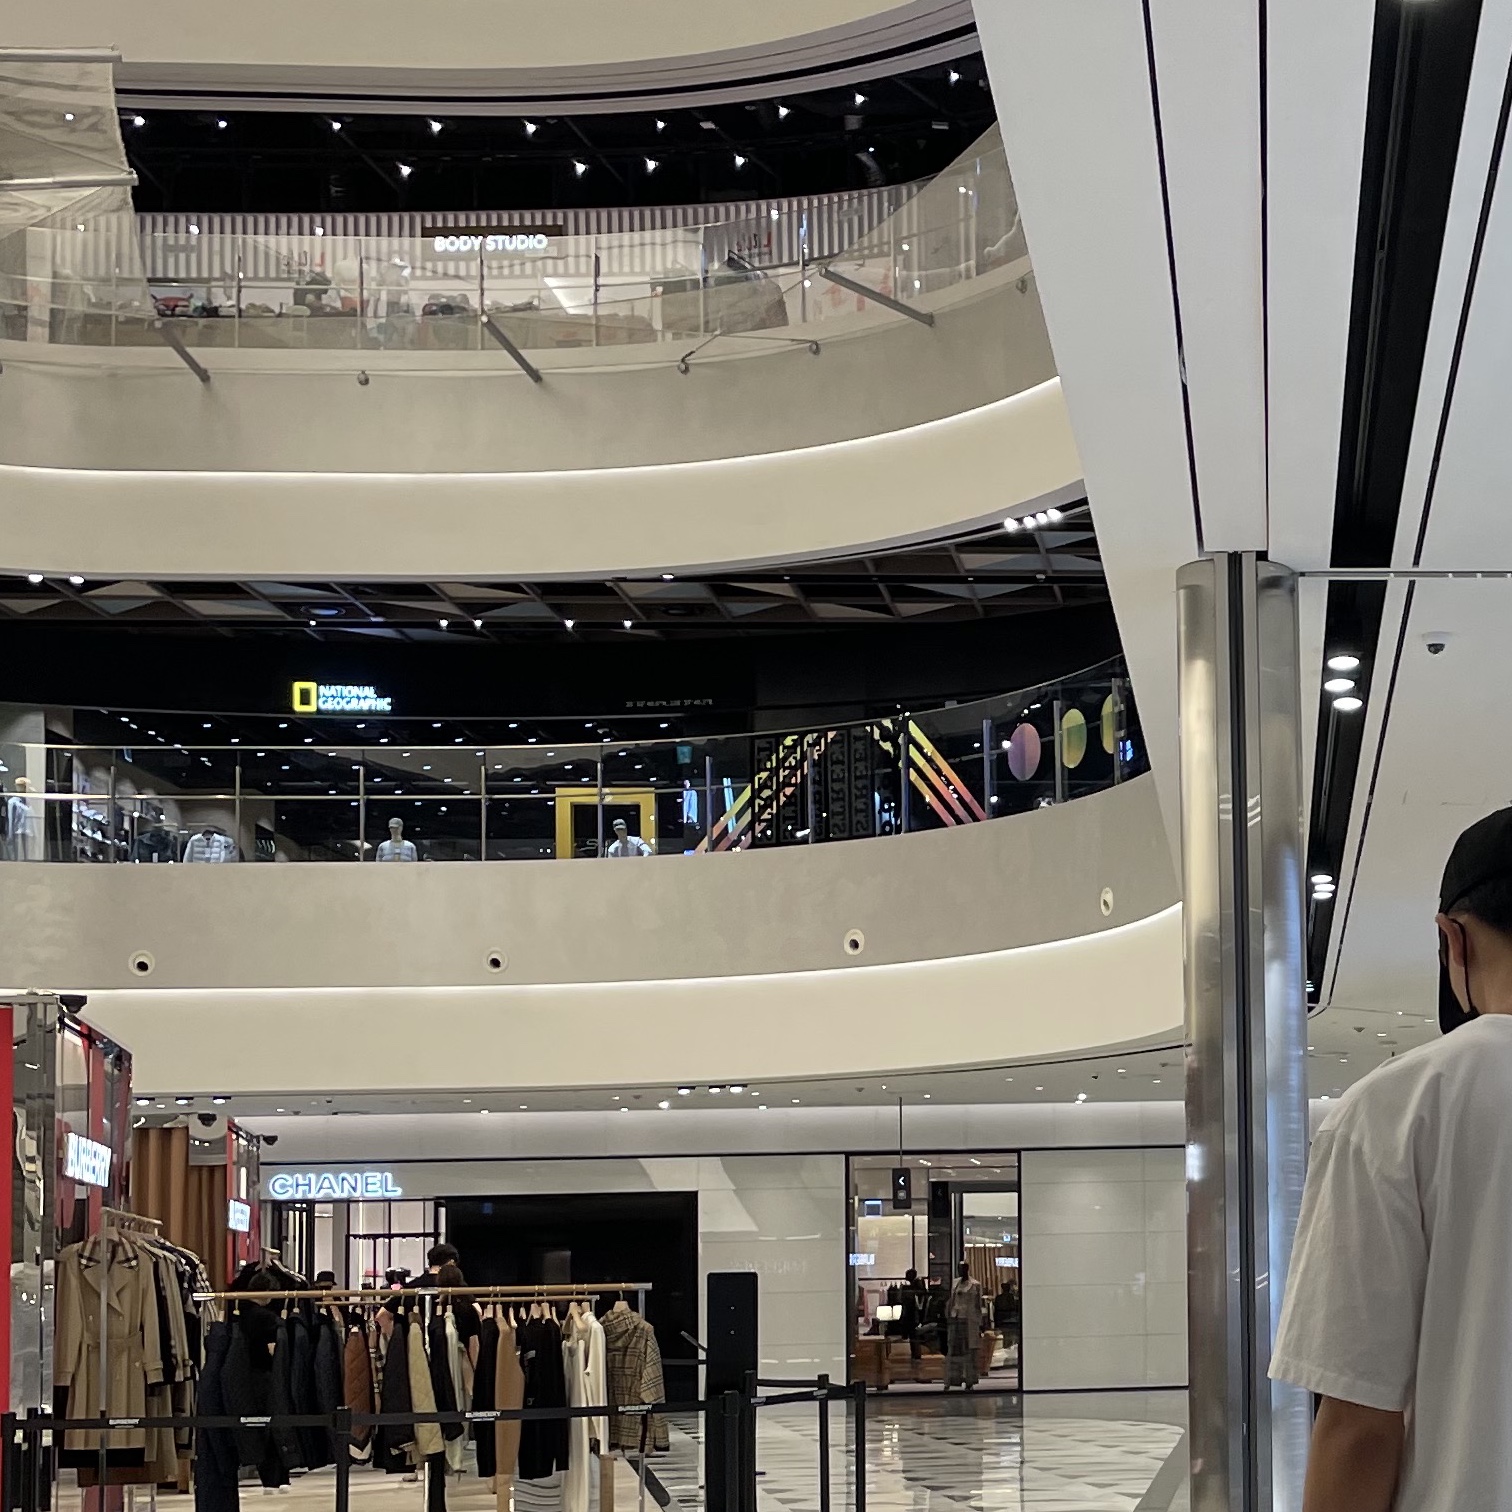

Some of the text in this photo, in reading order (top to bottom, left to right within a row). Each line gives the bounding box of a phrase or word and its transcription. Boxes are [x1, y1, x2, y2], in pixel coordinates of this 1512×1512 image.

[433, 234, 548, 252] BODY STUDIO
[319, 685, 377, 698] NATIONAL
[318, 697, 392, 711] GEOGRAPHIC
[269, 1172, 402, 1199] CHANEL
